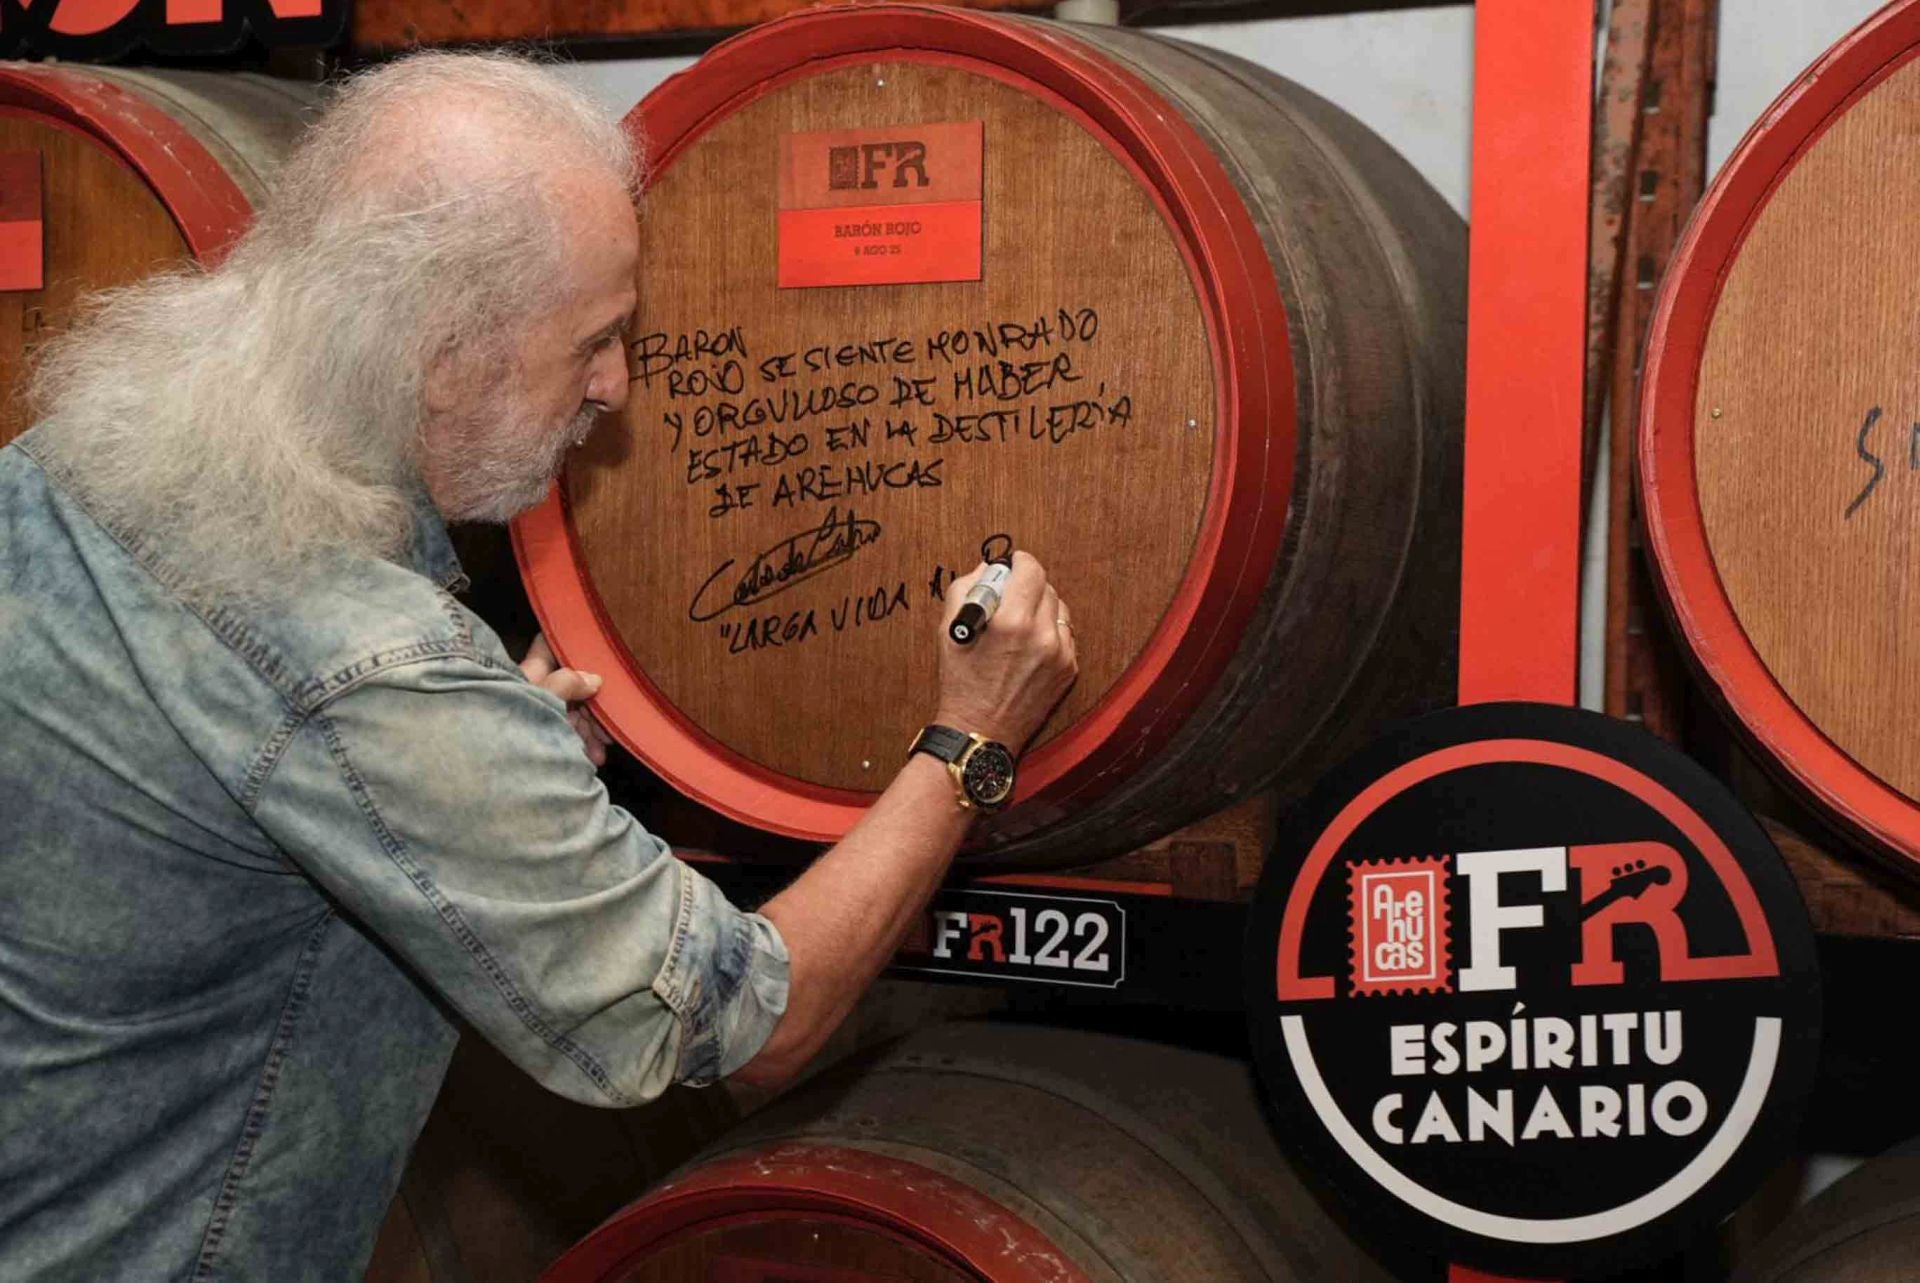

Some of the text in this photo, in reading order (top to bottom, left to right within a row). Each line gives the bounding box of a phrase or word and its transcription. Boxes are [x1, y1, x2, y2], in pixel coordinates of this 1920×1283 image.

[860, 141, 930, 189] FR
[628, 327, 748, 389] BARON
[759, 352, 797, 382] SE
[804, 338, 916, 372] SIENTE
[928, 308, 1098, 363] HONRADO
[663, 352, 1083, 453] Y ORGULLOSO DE HABER
[687, 432, 809, 484] ESTADO
[826, 418, 871, 452] EN
[886, 419, 917, 447] LA
[1843, 404, 1920, 521] S
[709, 459, 944, 518] DE AREHUCAS
[831, 582, 910, 632] VIDA
[1390, 1001, 1683, 1077] ESPÍRITU
[1371, 1079, 1709, 1148] CANARIO
